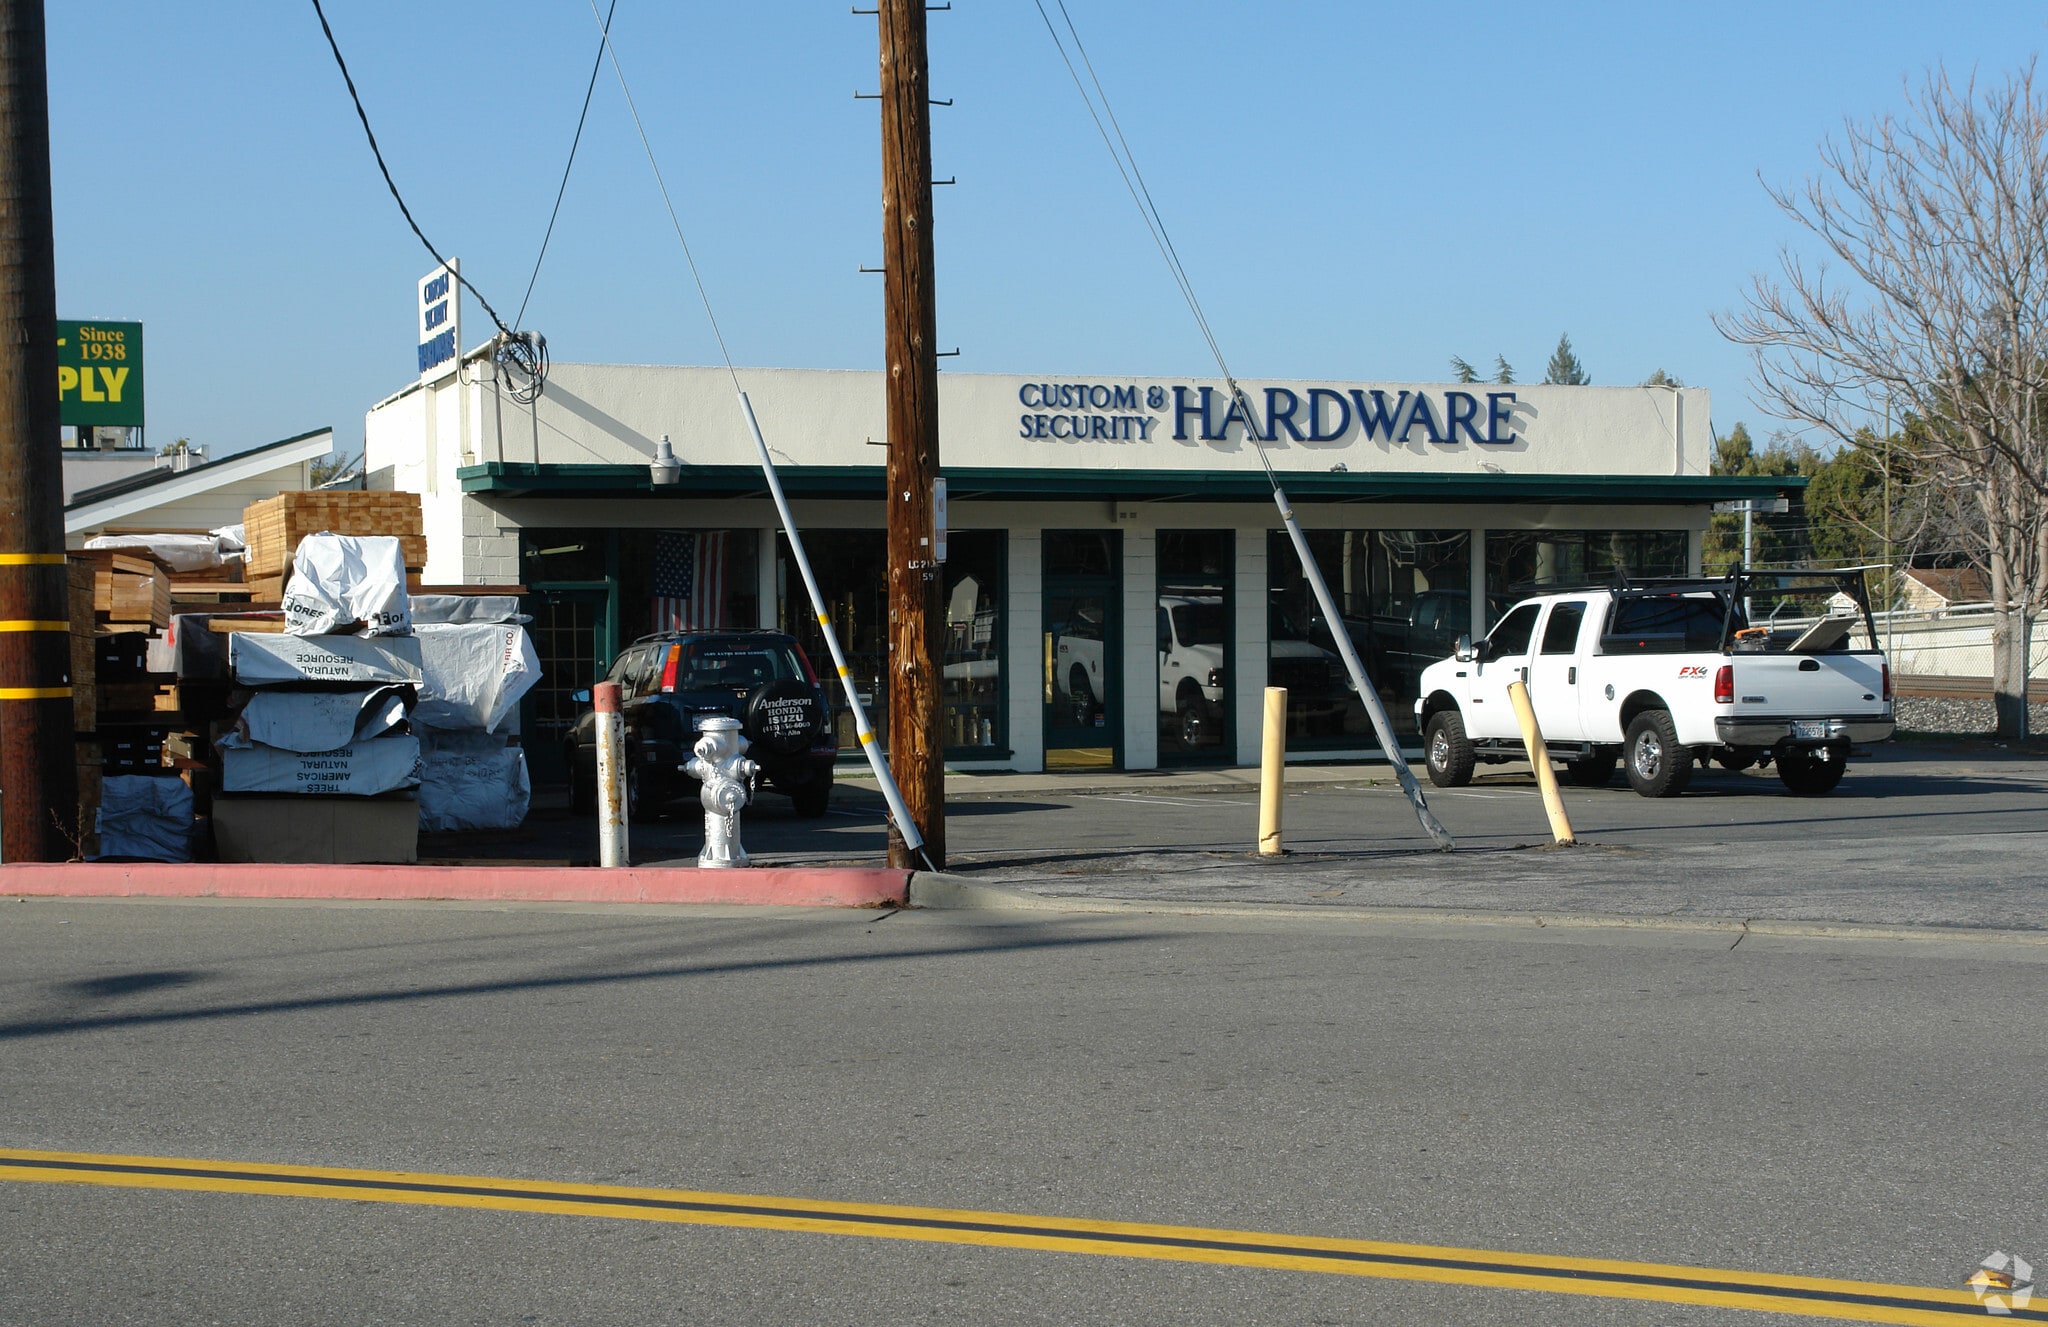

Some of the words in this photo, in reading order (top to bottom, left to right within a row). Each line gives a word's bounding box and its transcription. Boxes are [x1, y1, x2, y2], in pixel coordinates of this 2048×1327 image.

[80, 326, 125, 342] Since
[80, 343, 126, 360] 1938
[58, 366, 130, 402] PLY
[1019, 383, 1136, 409] CUSTOM
[1146, 385, 1164, 409] &
[1172, 385, 1517, 445] HARDWARE
[1020, 414, 1154, 440] SECURITY
[922, 572, 935, 581] 59
[296, 653, 354, 664] RESOURCE
[301, 666, 349, 675] NATURAL
[1679, 666, 1709, 676] FX4
[759, 696, 812, 710] Anderson
[767, 706, 804, 717] HONDA
[768, 714, 804, 725] ISUZU
[301, 760, 348, 769] NATURAL
[297, 772, 352, 781] AMERICAS
[307, 784, 340, 792] TREES
